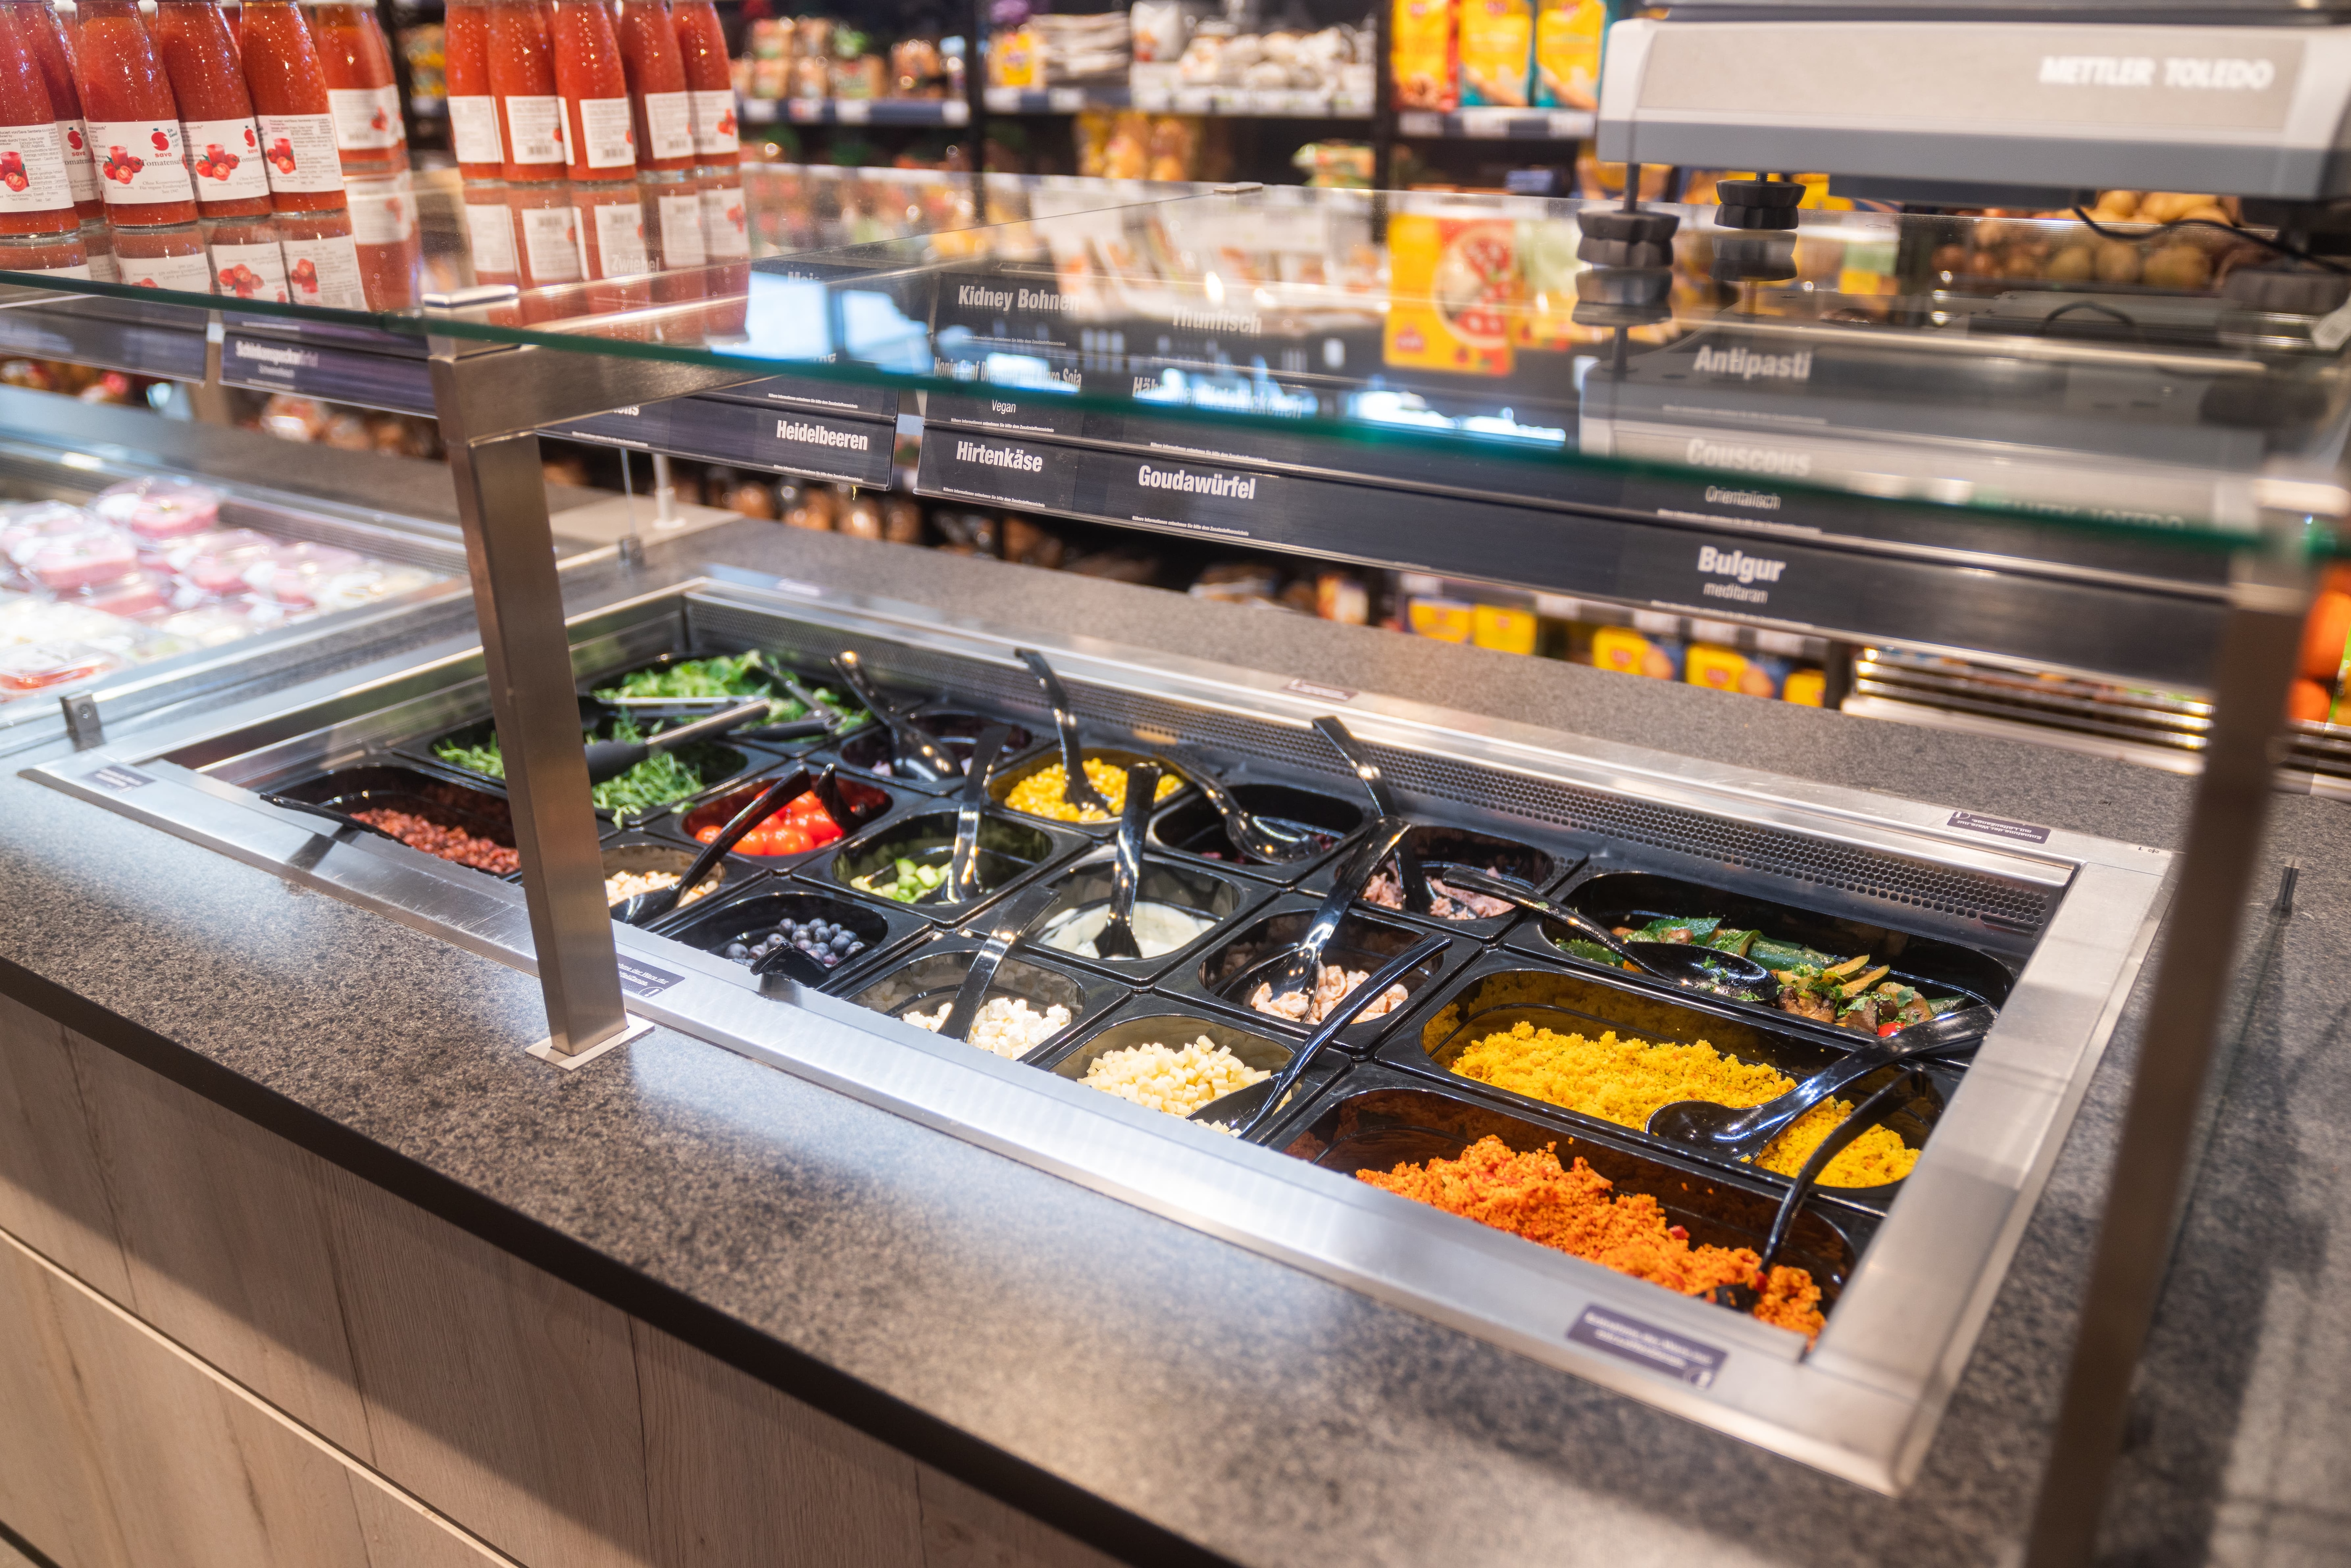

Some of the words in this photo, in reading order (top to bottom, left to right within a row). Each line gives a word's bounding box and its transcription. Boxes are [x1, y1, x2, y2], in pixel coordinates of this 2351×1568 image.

[2040, 56, 2154, 86] METTLER
[2164, 58, 2275, 89] TOLEDO
[958, 285, 1013, 312] Kidney
[1018, 288, 1080, 311] Bohnen
[1172, 305, 1262, 334] Thunfisch
[934, 356, 958, 379] Honig
[1693, 344, 1814, 381] Antipasti
[992, 399, 1016, 415] Vegan
[777, 419, 868, 451] Heidelbeeren
[956, 441, 1043, 472] Hirtenkäse
[1686, 437, 1813, 477] Couscous
[1138, 465, 1256, 499] Goudawürfel
[1011, 498, 1045, 508] Zusatzstoffverzeichnis
[1705, 485, 1782, 510] Orientalisch
[1210, 526, 1249, 536] Zusatzstoffverzeichnis
[1697, 545, 1787, 584] Bulgur
